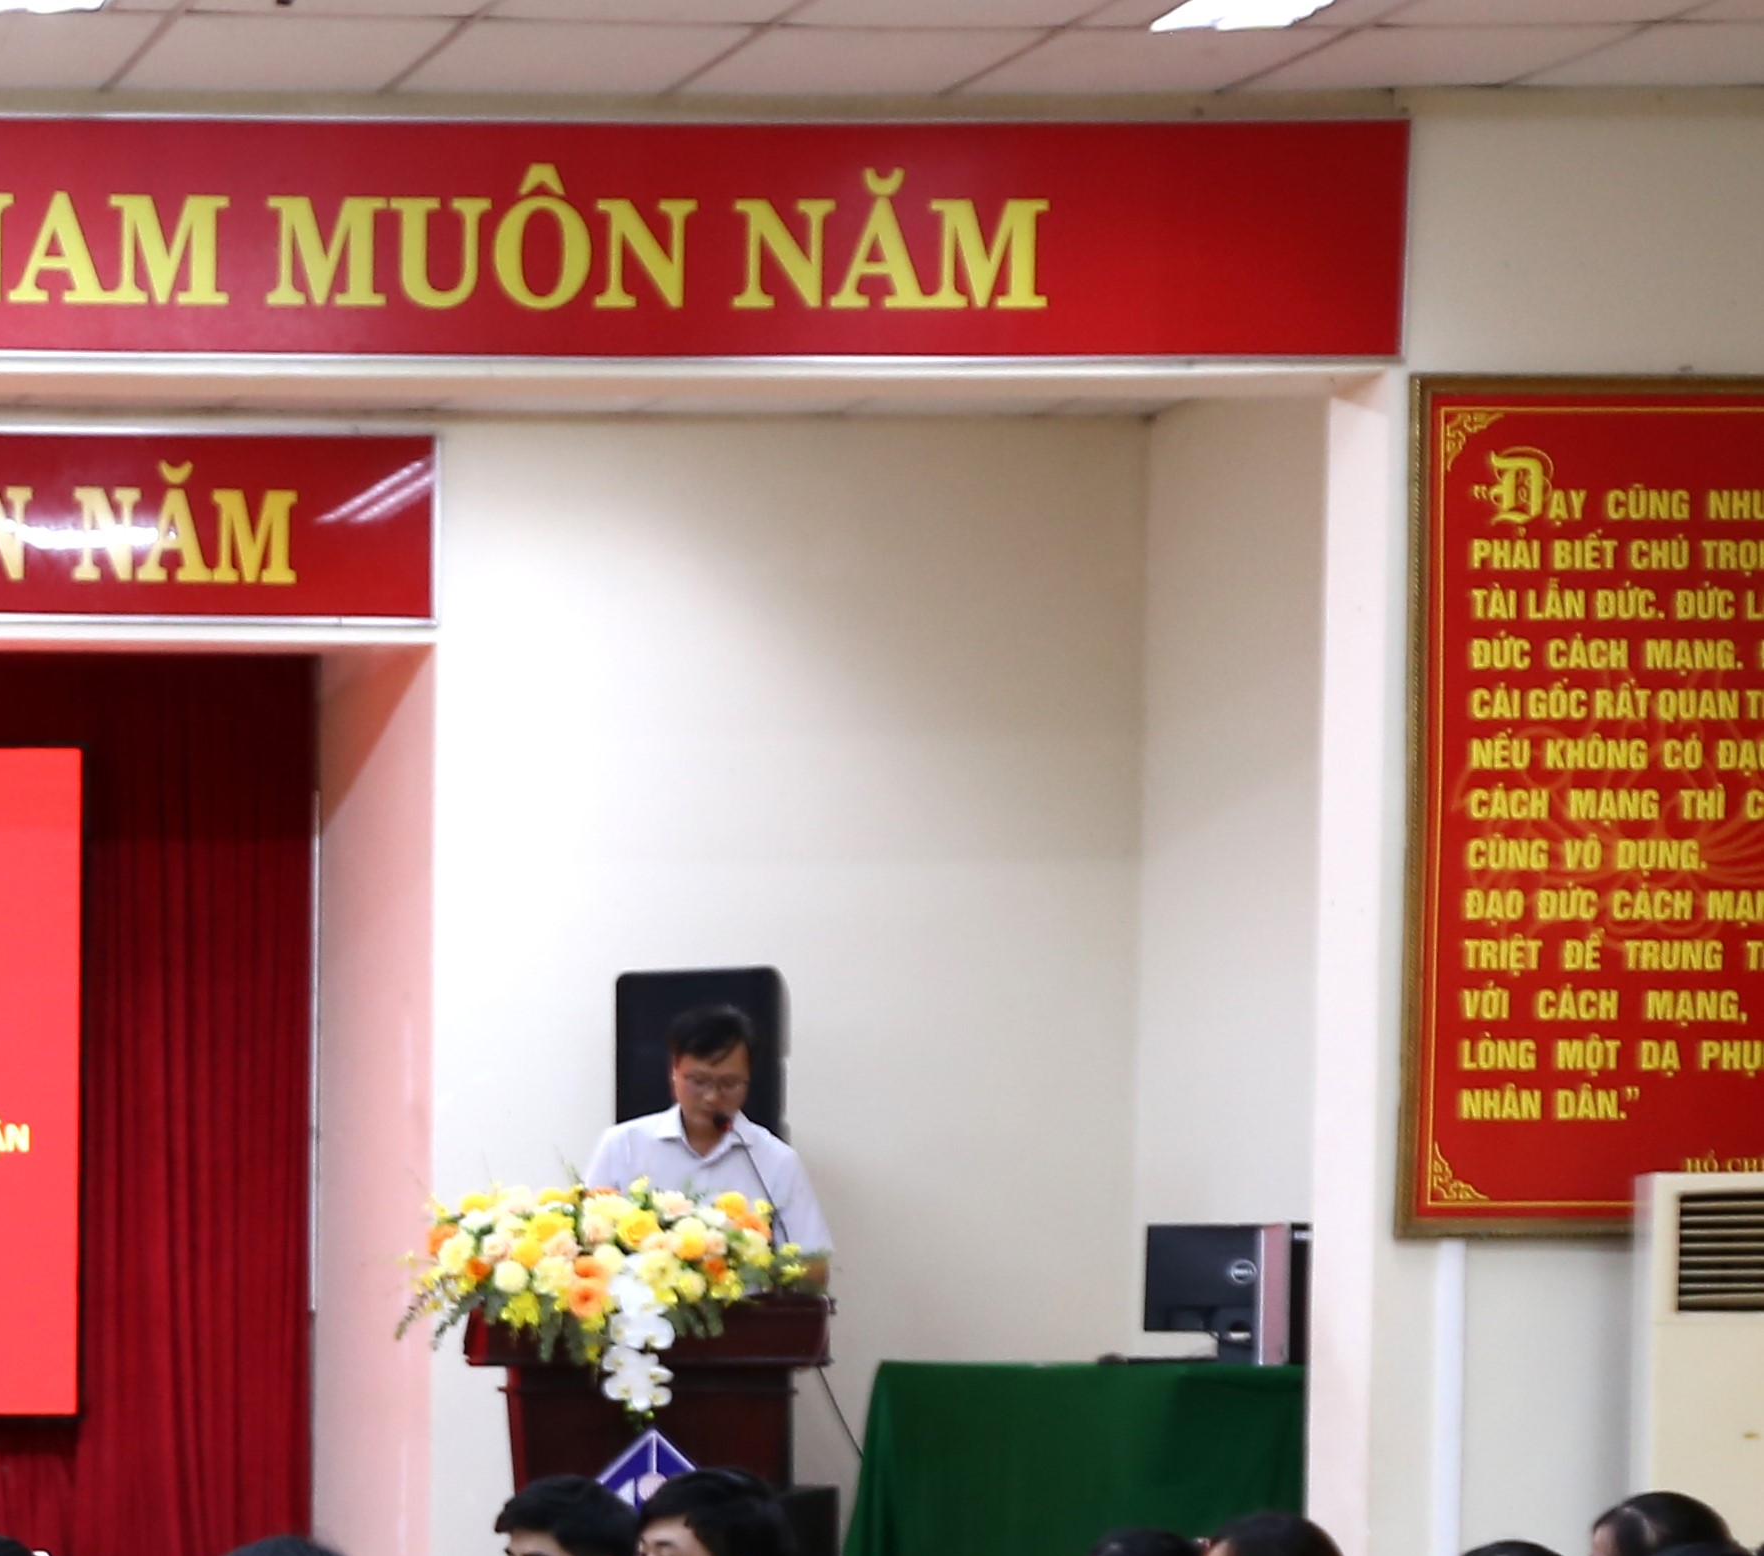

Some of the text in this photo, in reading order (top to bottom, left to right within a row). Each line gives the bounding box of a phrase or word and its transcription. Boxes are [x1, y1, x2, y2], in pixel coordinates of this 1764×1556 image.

[265, 164, 694, 310] MUÔN
[734, 170, 1048, 310] NĂM
[75, 464, 296, 585] NĂM
[1606, 483, 1690, 521] CŨNG
[1472, 526, 1541, 571] PHẢI
[1554, 529, 1619, 571] BIẾT
[1630, 534, 1690, 571] CHÚ
[1473, 582, 1517, 620] TÀI
[1528, 577, 1586, 620] LẪN
[1596, 581, 1665, 620] ĐỨC.
[1676, 581, 1736, 620] ĐỨC
[1472, 630, 1532, 670] ĐỨC
[1548, 632, 1629, 670] CÁCH
[1646, 639, 1744, 677] MẠNG.
[1472, 682, 1521, 719] CÁI
[1528, 677, 1588, 719] GỐC
[1595, 677, 1651, 719] RẤT
[1657, 689, 1739, 722] QUAN
[1472, 728, 1531, 770] NẾU
[1546, 733, 1649, 770] KHÔNG
[1663, 732, 1703, 770] CÓ
[1472, 782, 1550, 820] CÁCH
[1569, 789, 1660, 828] MẠNG
[1680, 783, 1725, 820] THÌ
[1469, 833, 1707, 876] CŨNG VÔ DỤNG.
[1465, 889, 1524, 926] ĐẠO
[1537, 881, 1599, 920] ĐỨC
[1612, 882, 1693, 920] CÁCH
[1464, 934, 1543, 977] TRIỆT
[1564, 928, 1605, 971] ĐỂ
[1625, 940, 1723, 971] TRUNG
[1462, 981, 1748, 1026] VỚI CÁCH MẠNG,
[1462, 1031, 1764, 1077] LÒNG MỘT DẠ PHỤ
[1462, 1083, 1541, 1120] NHÂN
